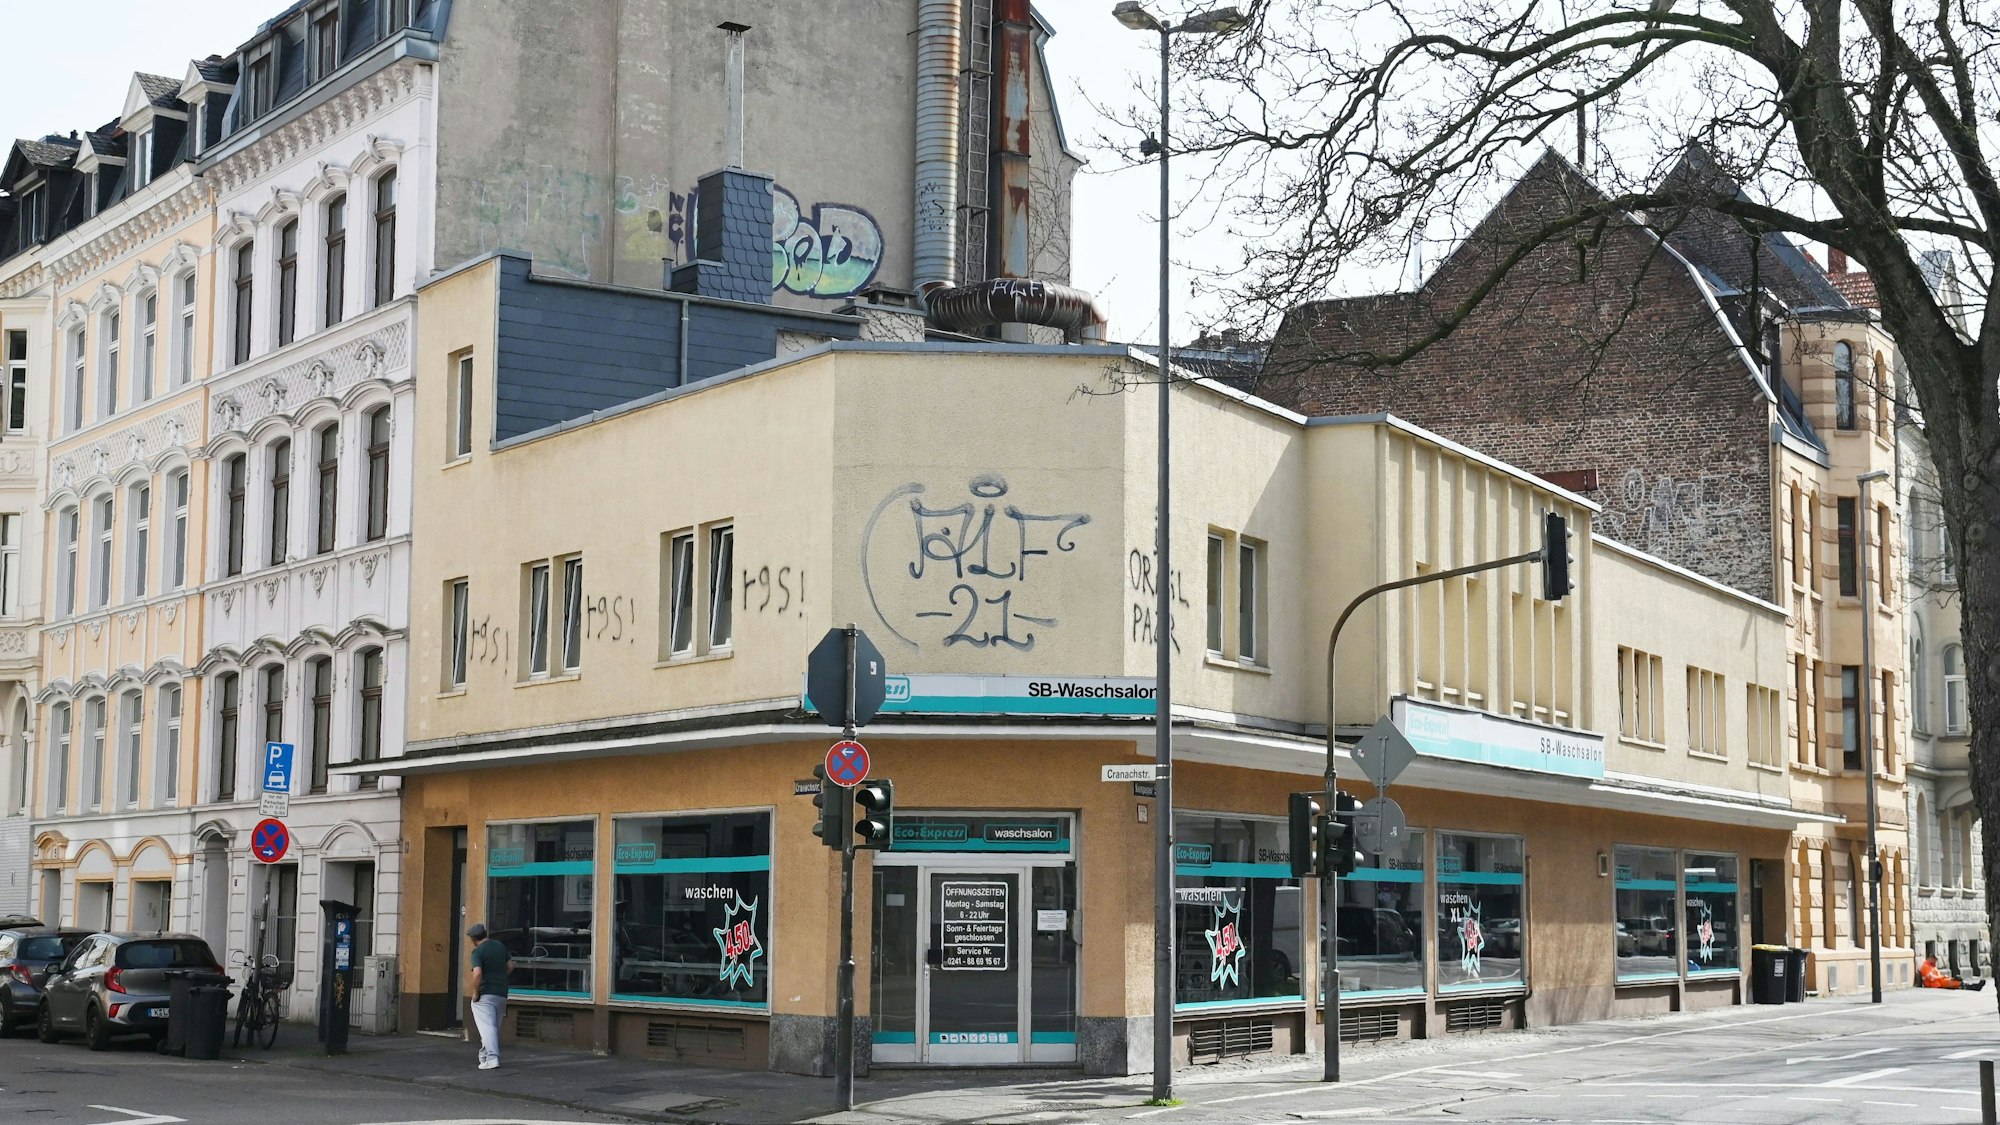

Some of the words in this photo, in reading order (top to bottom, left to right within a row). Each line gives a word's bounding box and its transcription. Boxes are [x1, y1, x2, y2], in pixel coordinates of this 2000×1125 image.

[1028, 682, 1158, 700] SB-Waschsalon
[269, 745, 283, 765] P
[1540, 737, 1603, 762] SB-Waschsalon
[1107, 768, 1151, 780] Cranachstr.
[894, 826, 965, 840] Eco-Express
[994, 828, 1053, 839] waschsalon
[617, 846, 655, 860] Eco-Express
[1176, 847, 1211, 863] Eco-Express
[1258, 848, 1291, 863] SB-Waschs
[684, 883, 734, 900] waschen
[945, 886, 1005, 897] ÖFFNUNGSZEITEN
[1180, 886, 1223, 902] waschen
[945, 899, 970, 910] Montag
[975, 899, 1005, 910] Samstag
[1440, 893, 1469, 904] waschen
[969, 911, 978, 919] 22
[978, 910, 990, 919] Uhr
[1450, 907, 1463, 923] XL
[946, 923, 966, 933] Sonn-
[966, 924, 972, 933] &
[972, 923, 1003, 935] Feiertags
[954, 932, 995, 943] geschlossen
[956, 946, 982, 956] Service
[983, 946, 993, 955] Nr.
[947, 957, 962, 966] 0241
[992, 957, 1001, 966] 67
